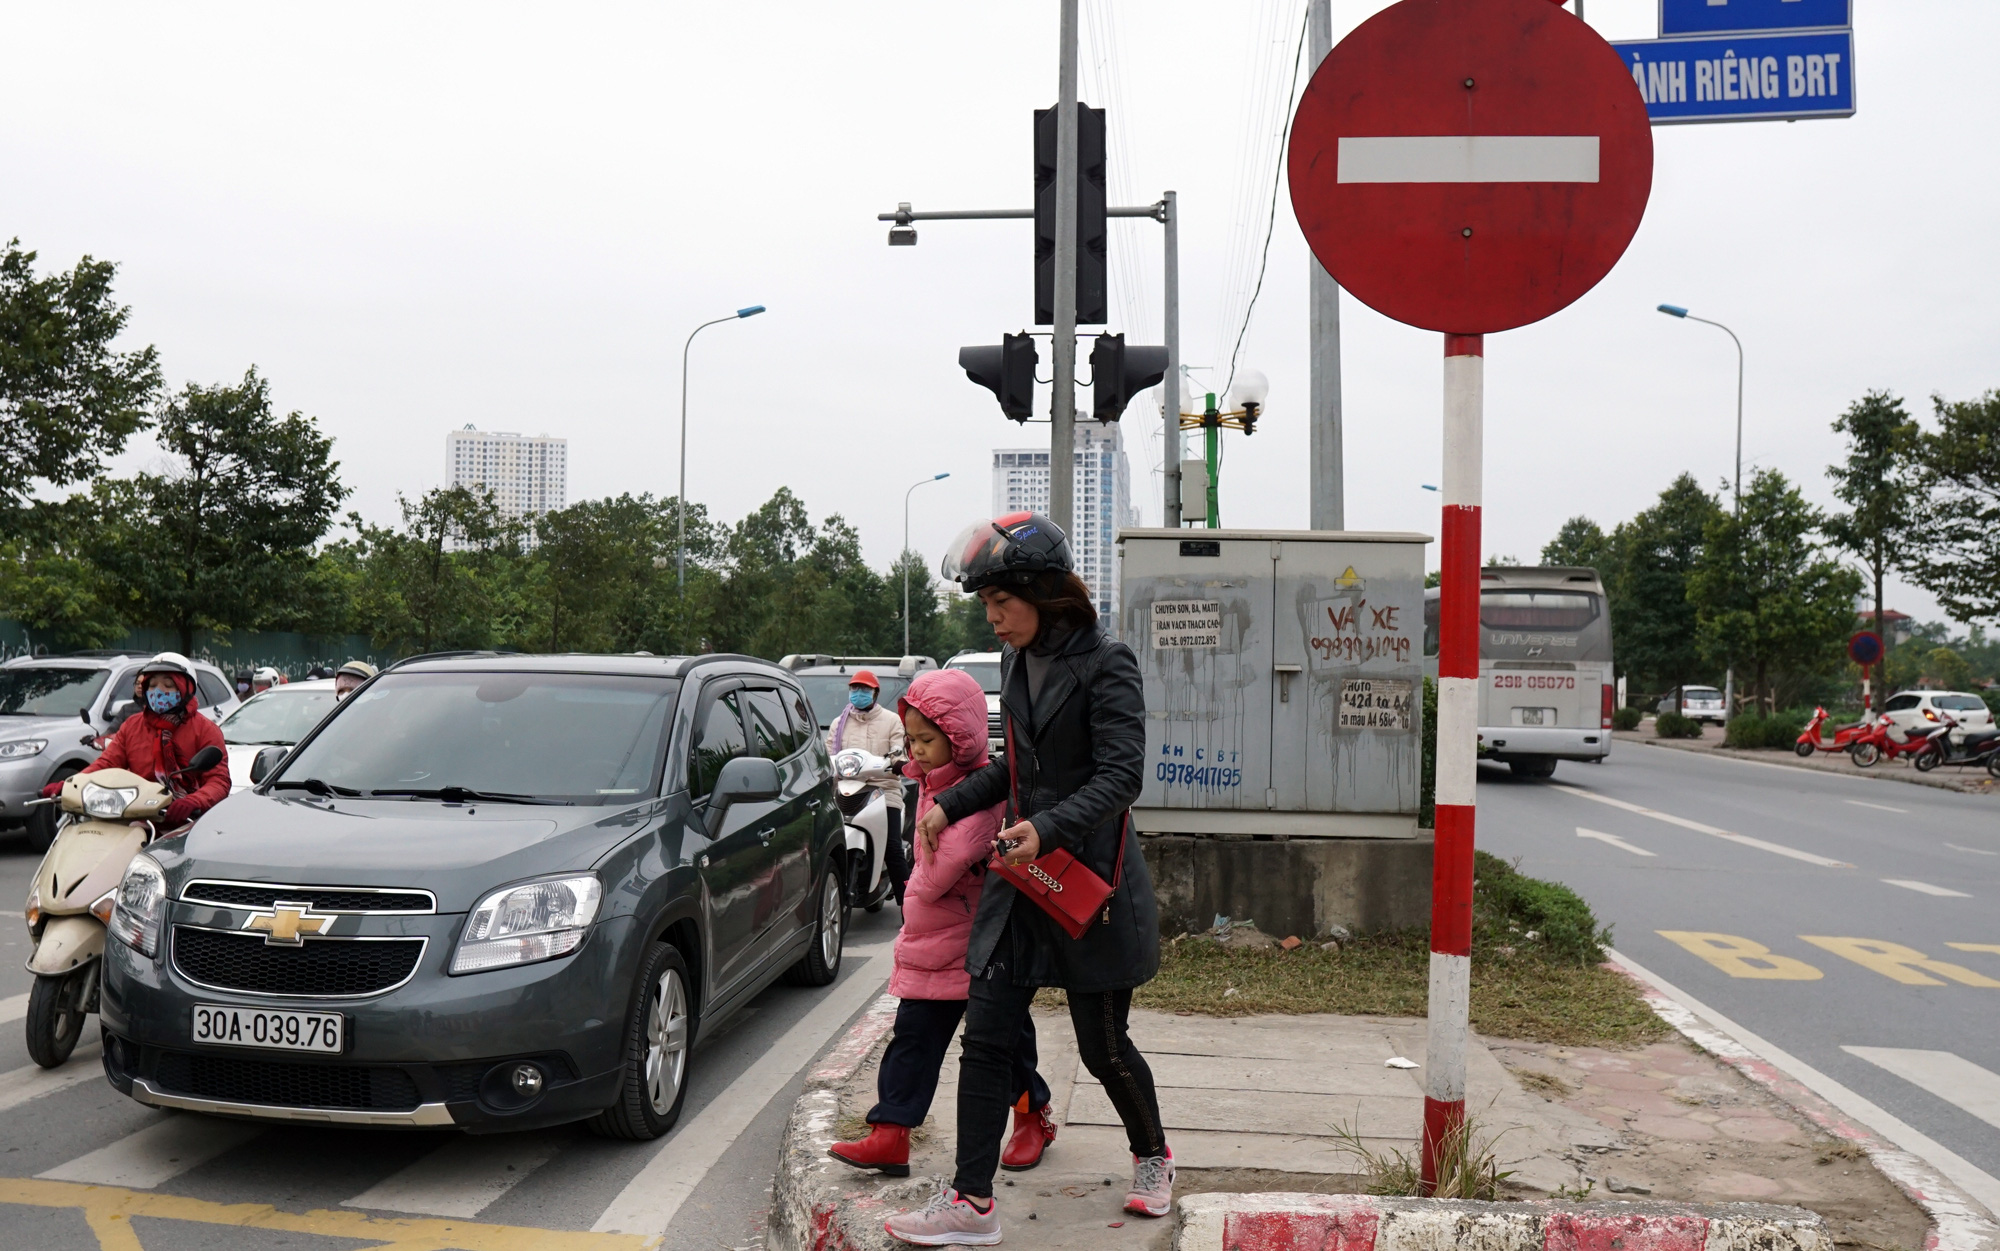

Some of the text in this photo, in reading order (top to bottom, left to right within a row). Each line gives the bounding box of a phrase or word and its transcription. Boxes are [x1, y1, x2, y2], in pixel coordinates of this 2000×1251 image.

[1632, 49, 1841, 104] ÀNH RIÊNG BRT
[1014, 526, 1039, 541] Sport
[1369, 605, 1400, 631] XE
[1489, 633, 1578, 647] UNIVERSE
[1345, 681, 1371, 692] HOTO
[1366, 711, 1377, 727] A4
[1156, 762, 1241, 788] 0978417195
[197, 1010, 337, 1048] 30A-039.76
